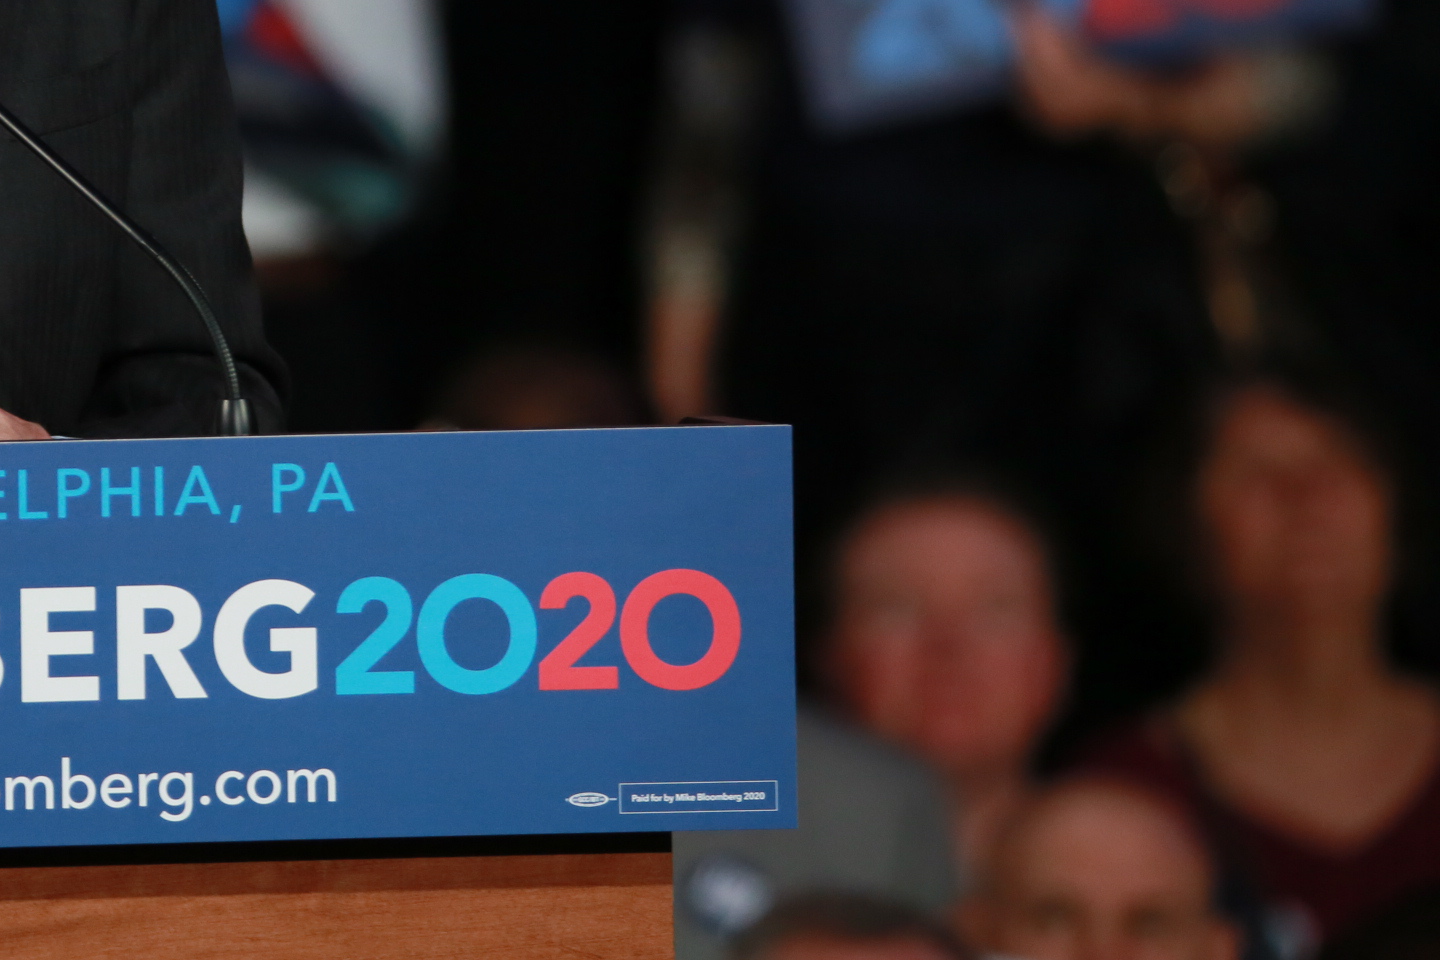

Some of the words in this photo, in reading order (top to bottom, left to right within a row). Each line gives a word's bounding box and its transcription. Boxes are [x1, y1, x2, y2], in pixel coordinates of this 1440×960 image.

[271, 461, 355, 514] PA
[631, 793, 649, 803] Paid
[650, 793, 663, 803] for
[663, 793, 674, 804] by
[675, 793, 696, 802] Mike
[696, 792, 742, 803] Bloomberg
[743, 791, 766, 801] 2020
